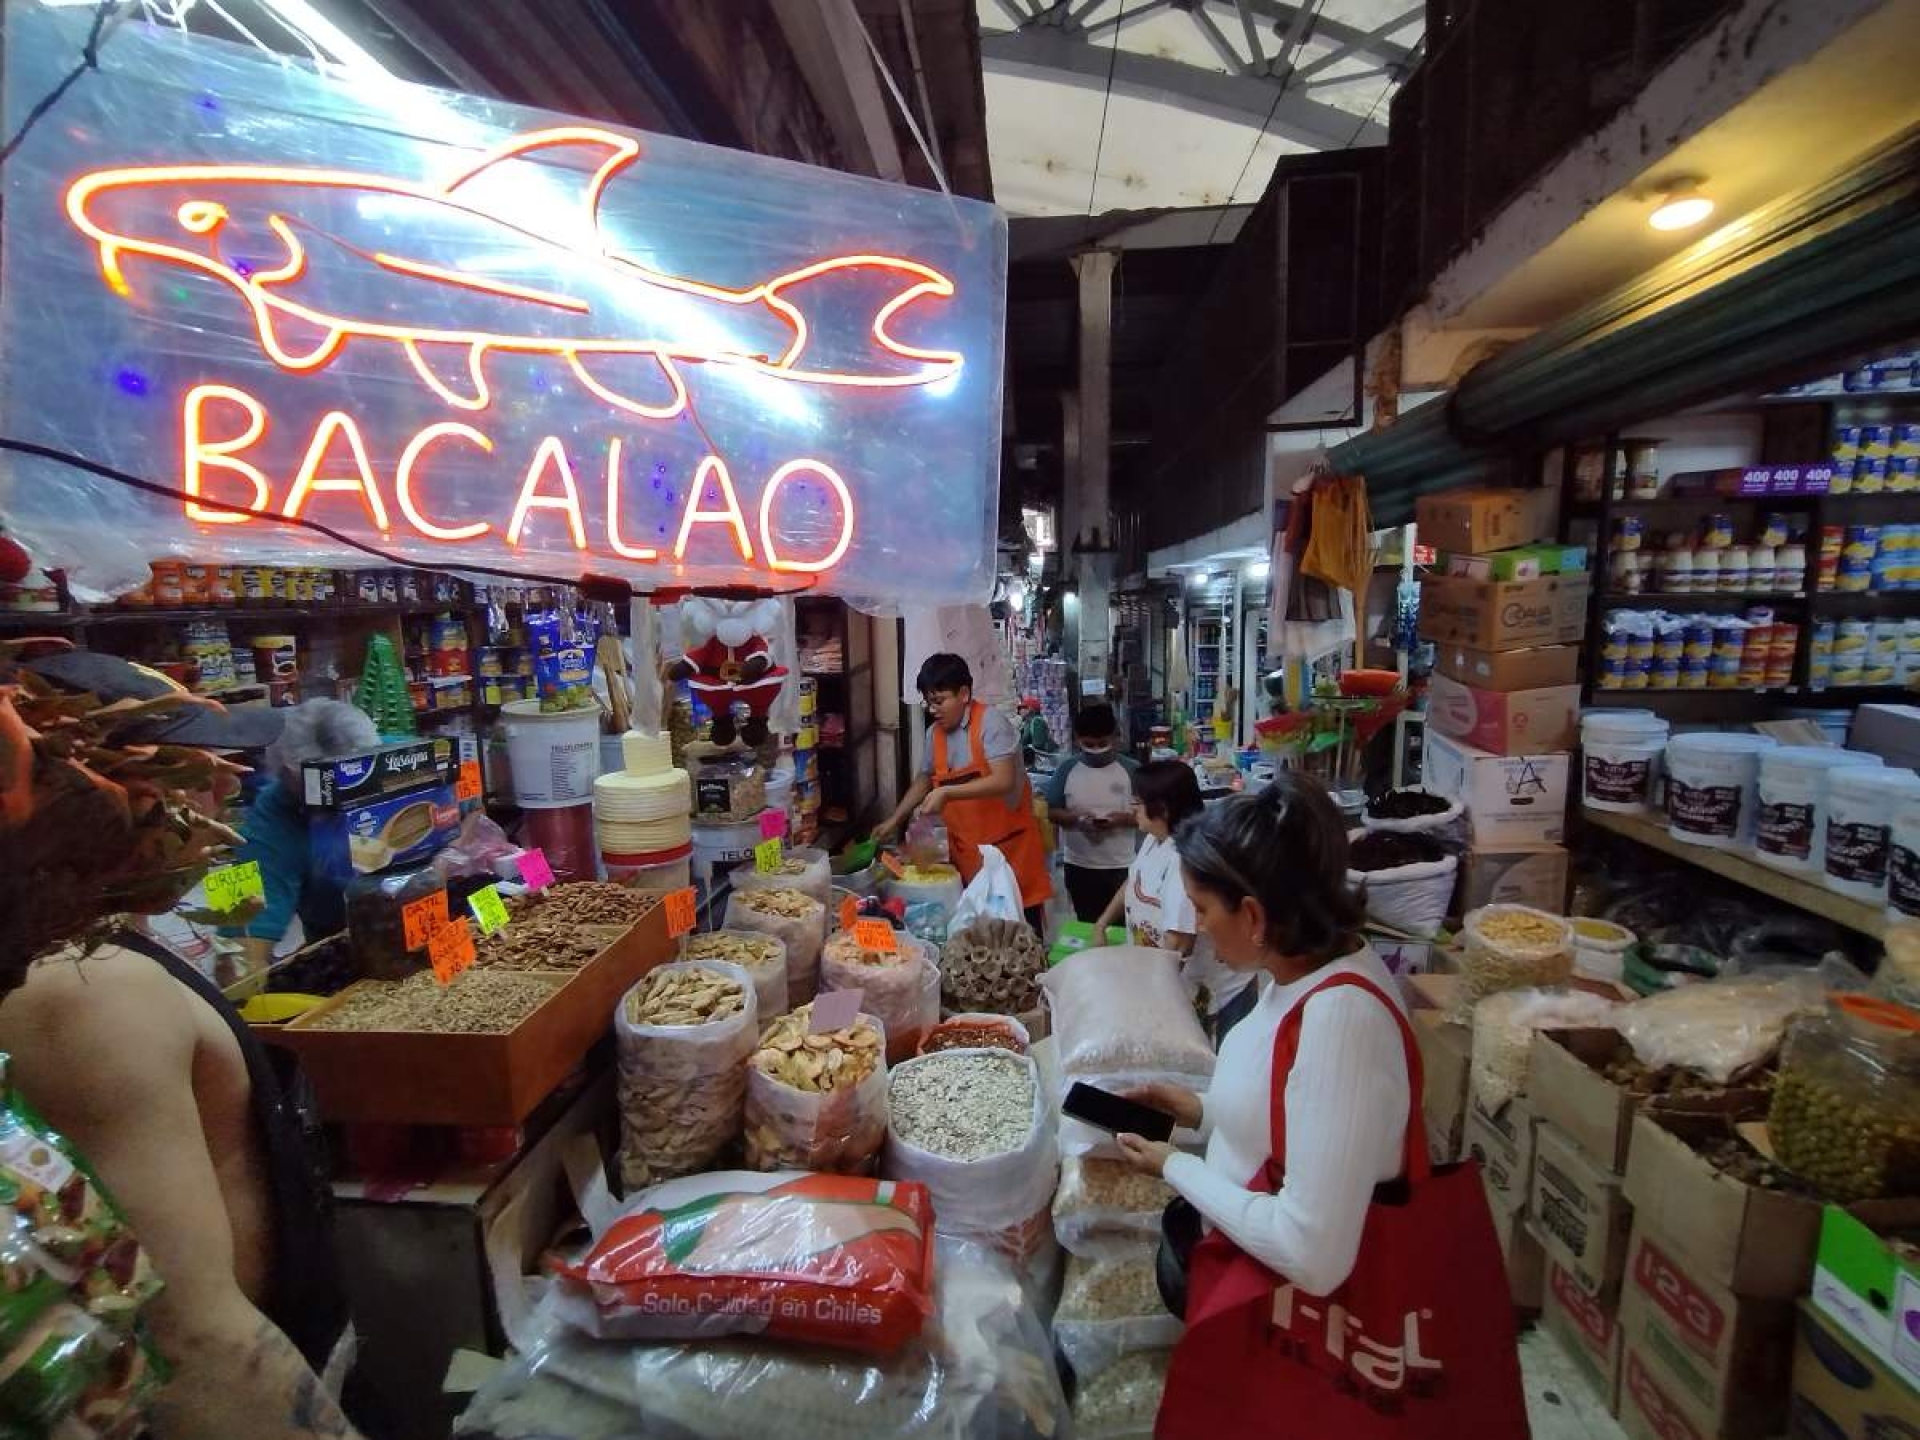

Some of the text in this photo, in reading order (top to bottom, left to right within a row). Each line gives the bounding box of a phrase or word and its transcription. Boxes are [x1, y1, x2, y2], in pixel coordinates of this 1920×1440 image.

[184, 384, 854, 573] BACALAO
[1744, 468, 1831, 482] 400 400 400
[780, 1299, 807, 1318] en
[814, 1294, 883, 1325] Chiles
